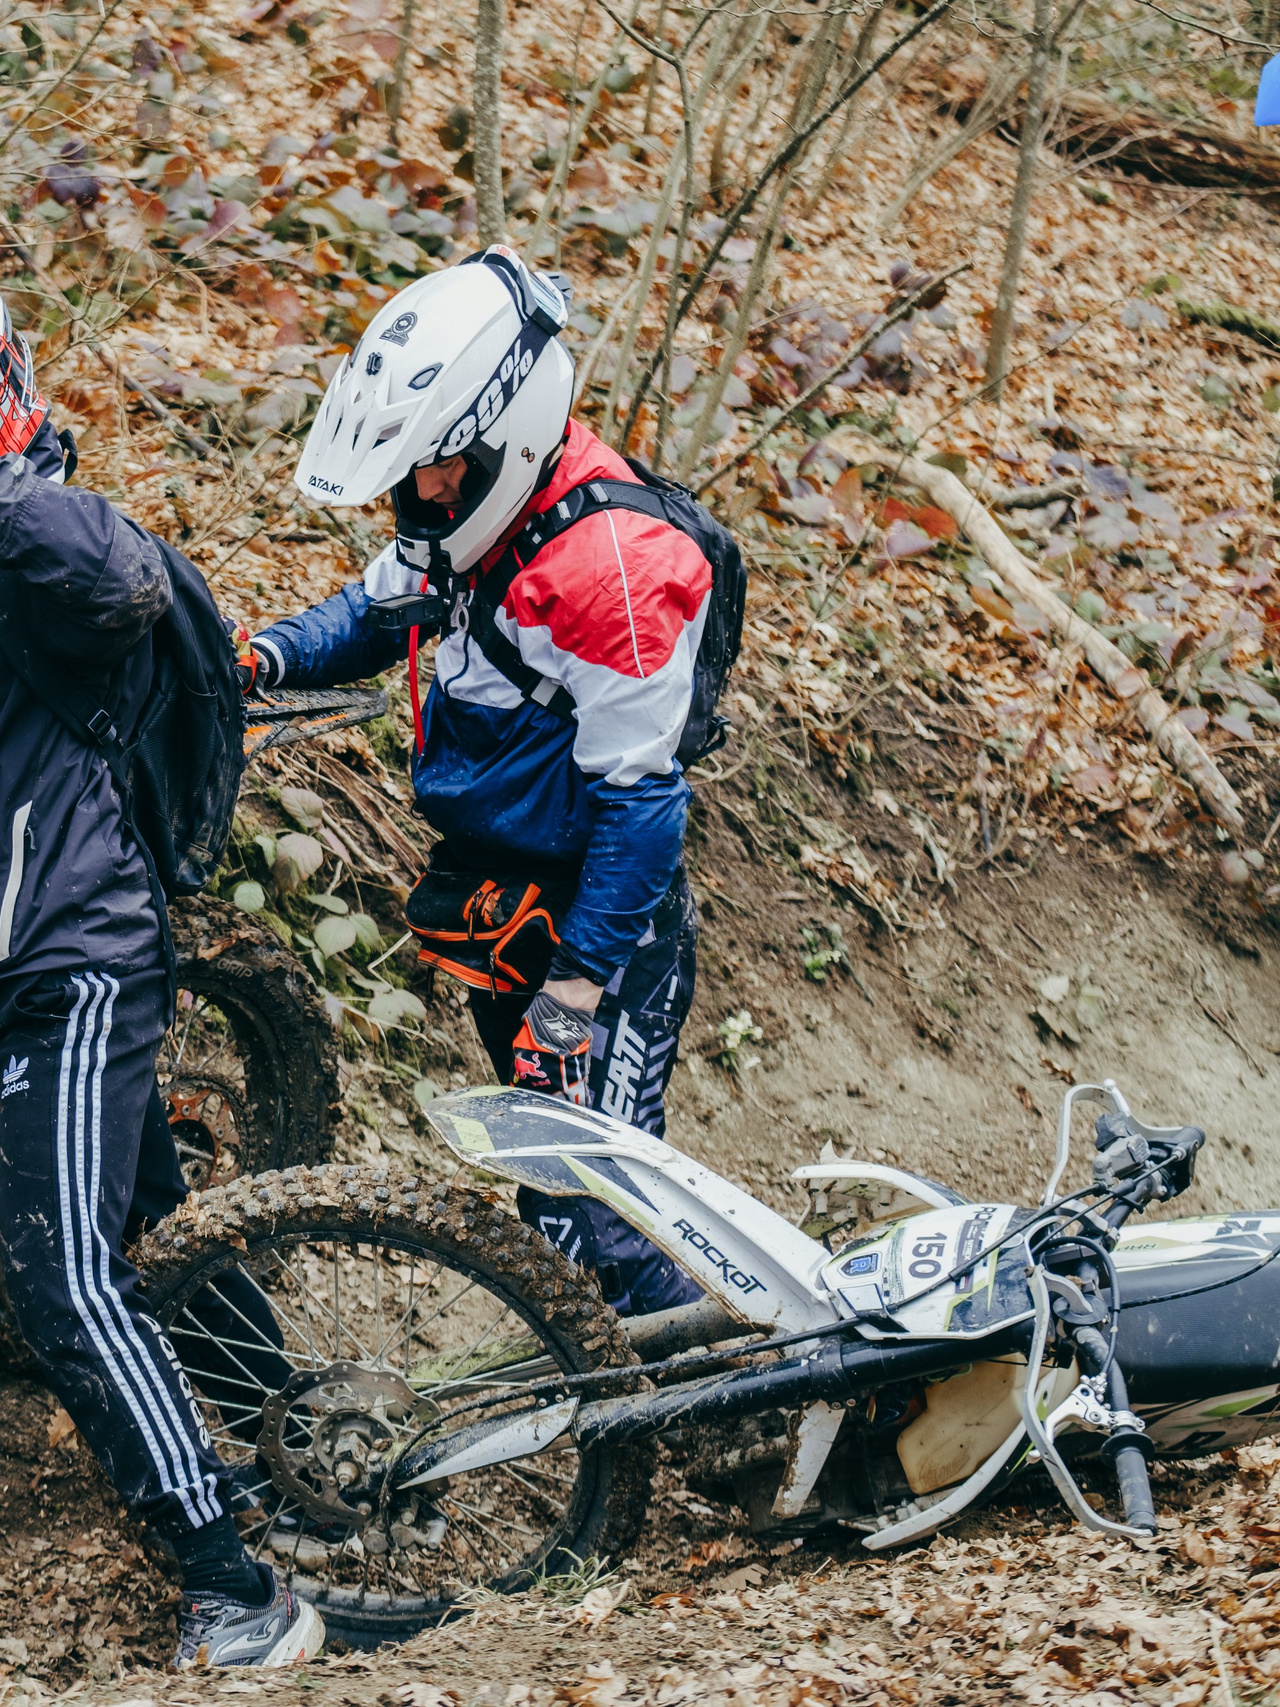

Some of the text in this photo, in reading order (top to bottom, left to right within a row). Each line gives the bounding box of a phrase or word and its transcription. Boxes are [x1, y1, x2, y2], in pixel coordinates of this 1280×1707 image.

[308, 475, 344, 496] ATAKI
[217, 958, 253, 978] GRIP
[601, 1009, 646, 1124] EATT
[672, 1217, 768, 1296] ROCKOT
[908, 1232, 948, 1279] 150
